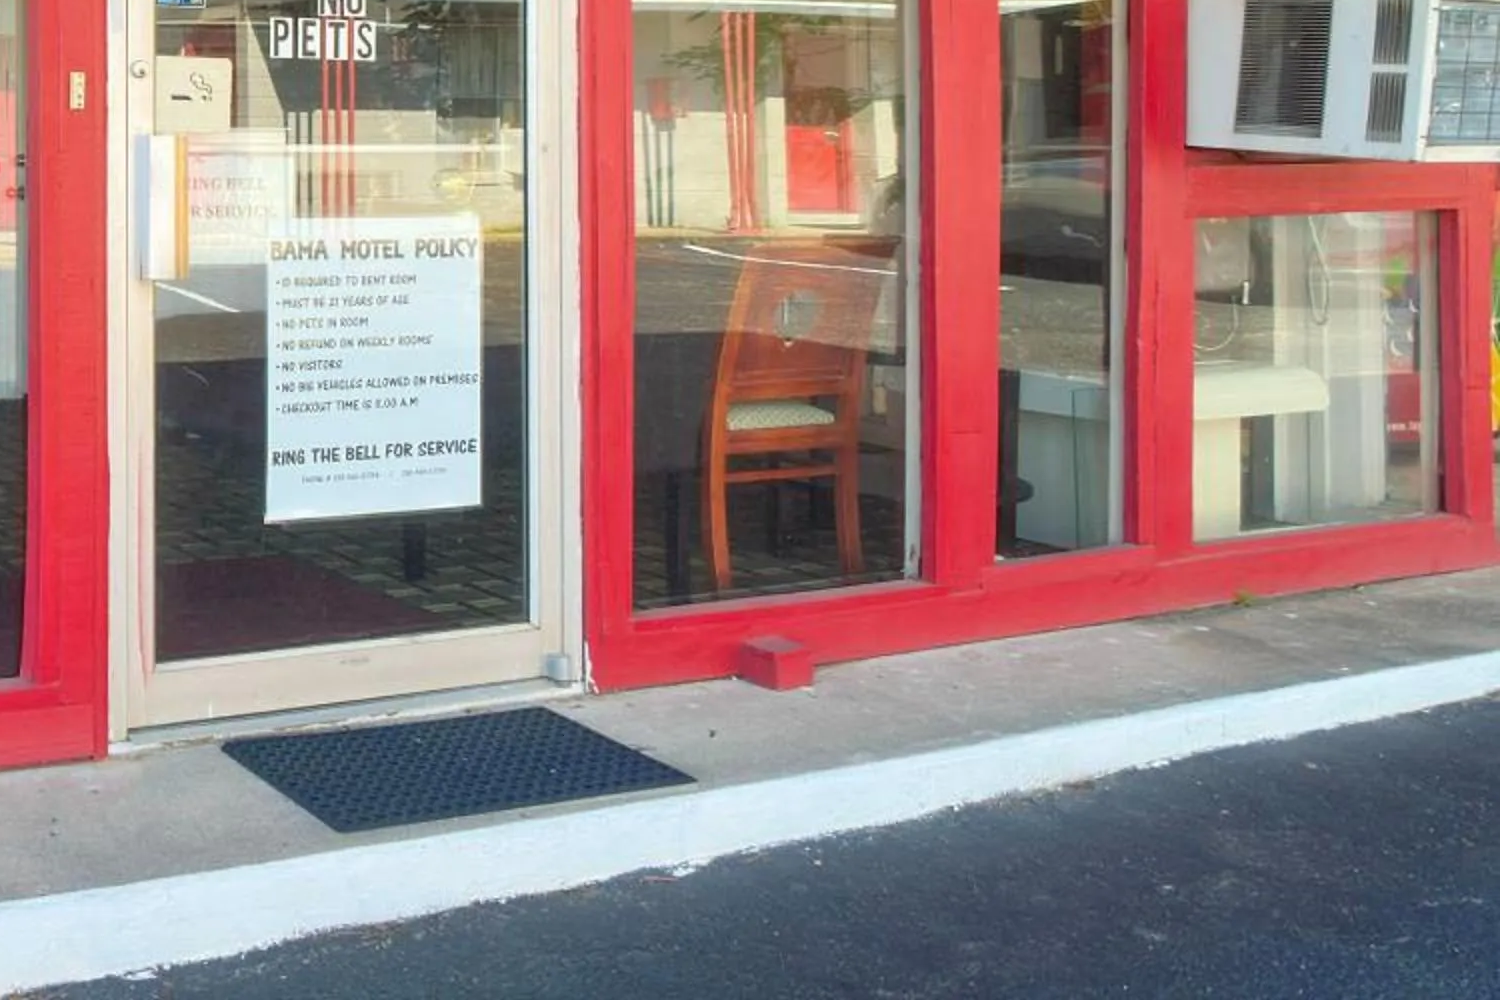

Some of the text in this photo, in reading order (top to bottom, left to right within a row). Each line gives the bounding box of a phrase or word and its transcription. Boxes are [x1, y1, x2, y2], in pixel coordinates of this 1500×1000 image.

[273, 17, 373, 59] PETS
[270, 240, 328, 261] BAMA
[341, 239, 404, 260] MOTEL
[272, 439, 478, 467] RING THE BELL FOR SERVICE
